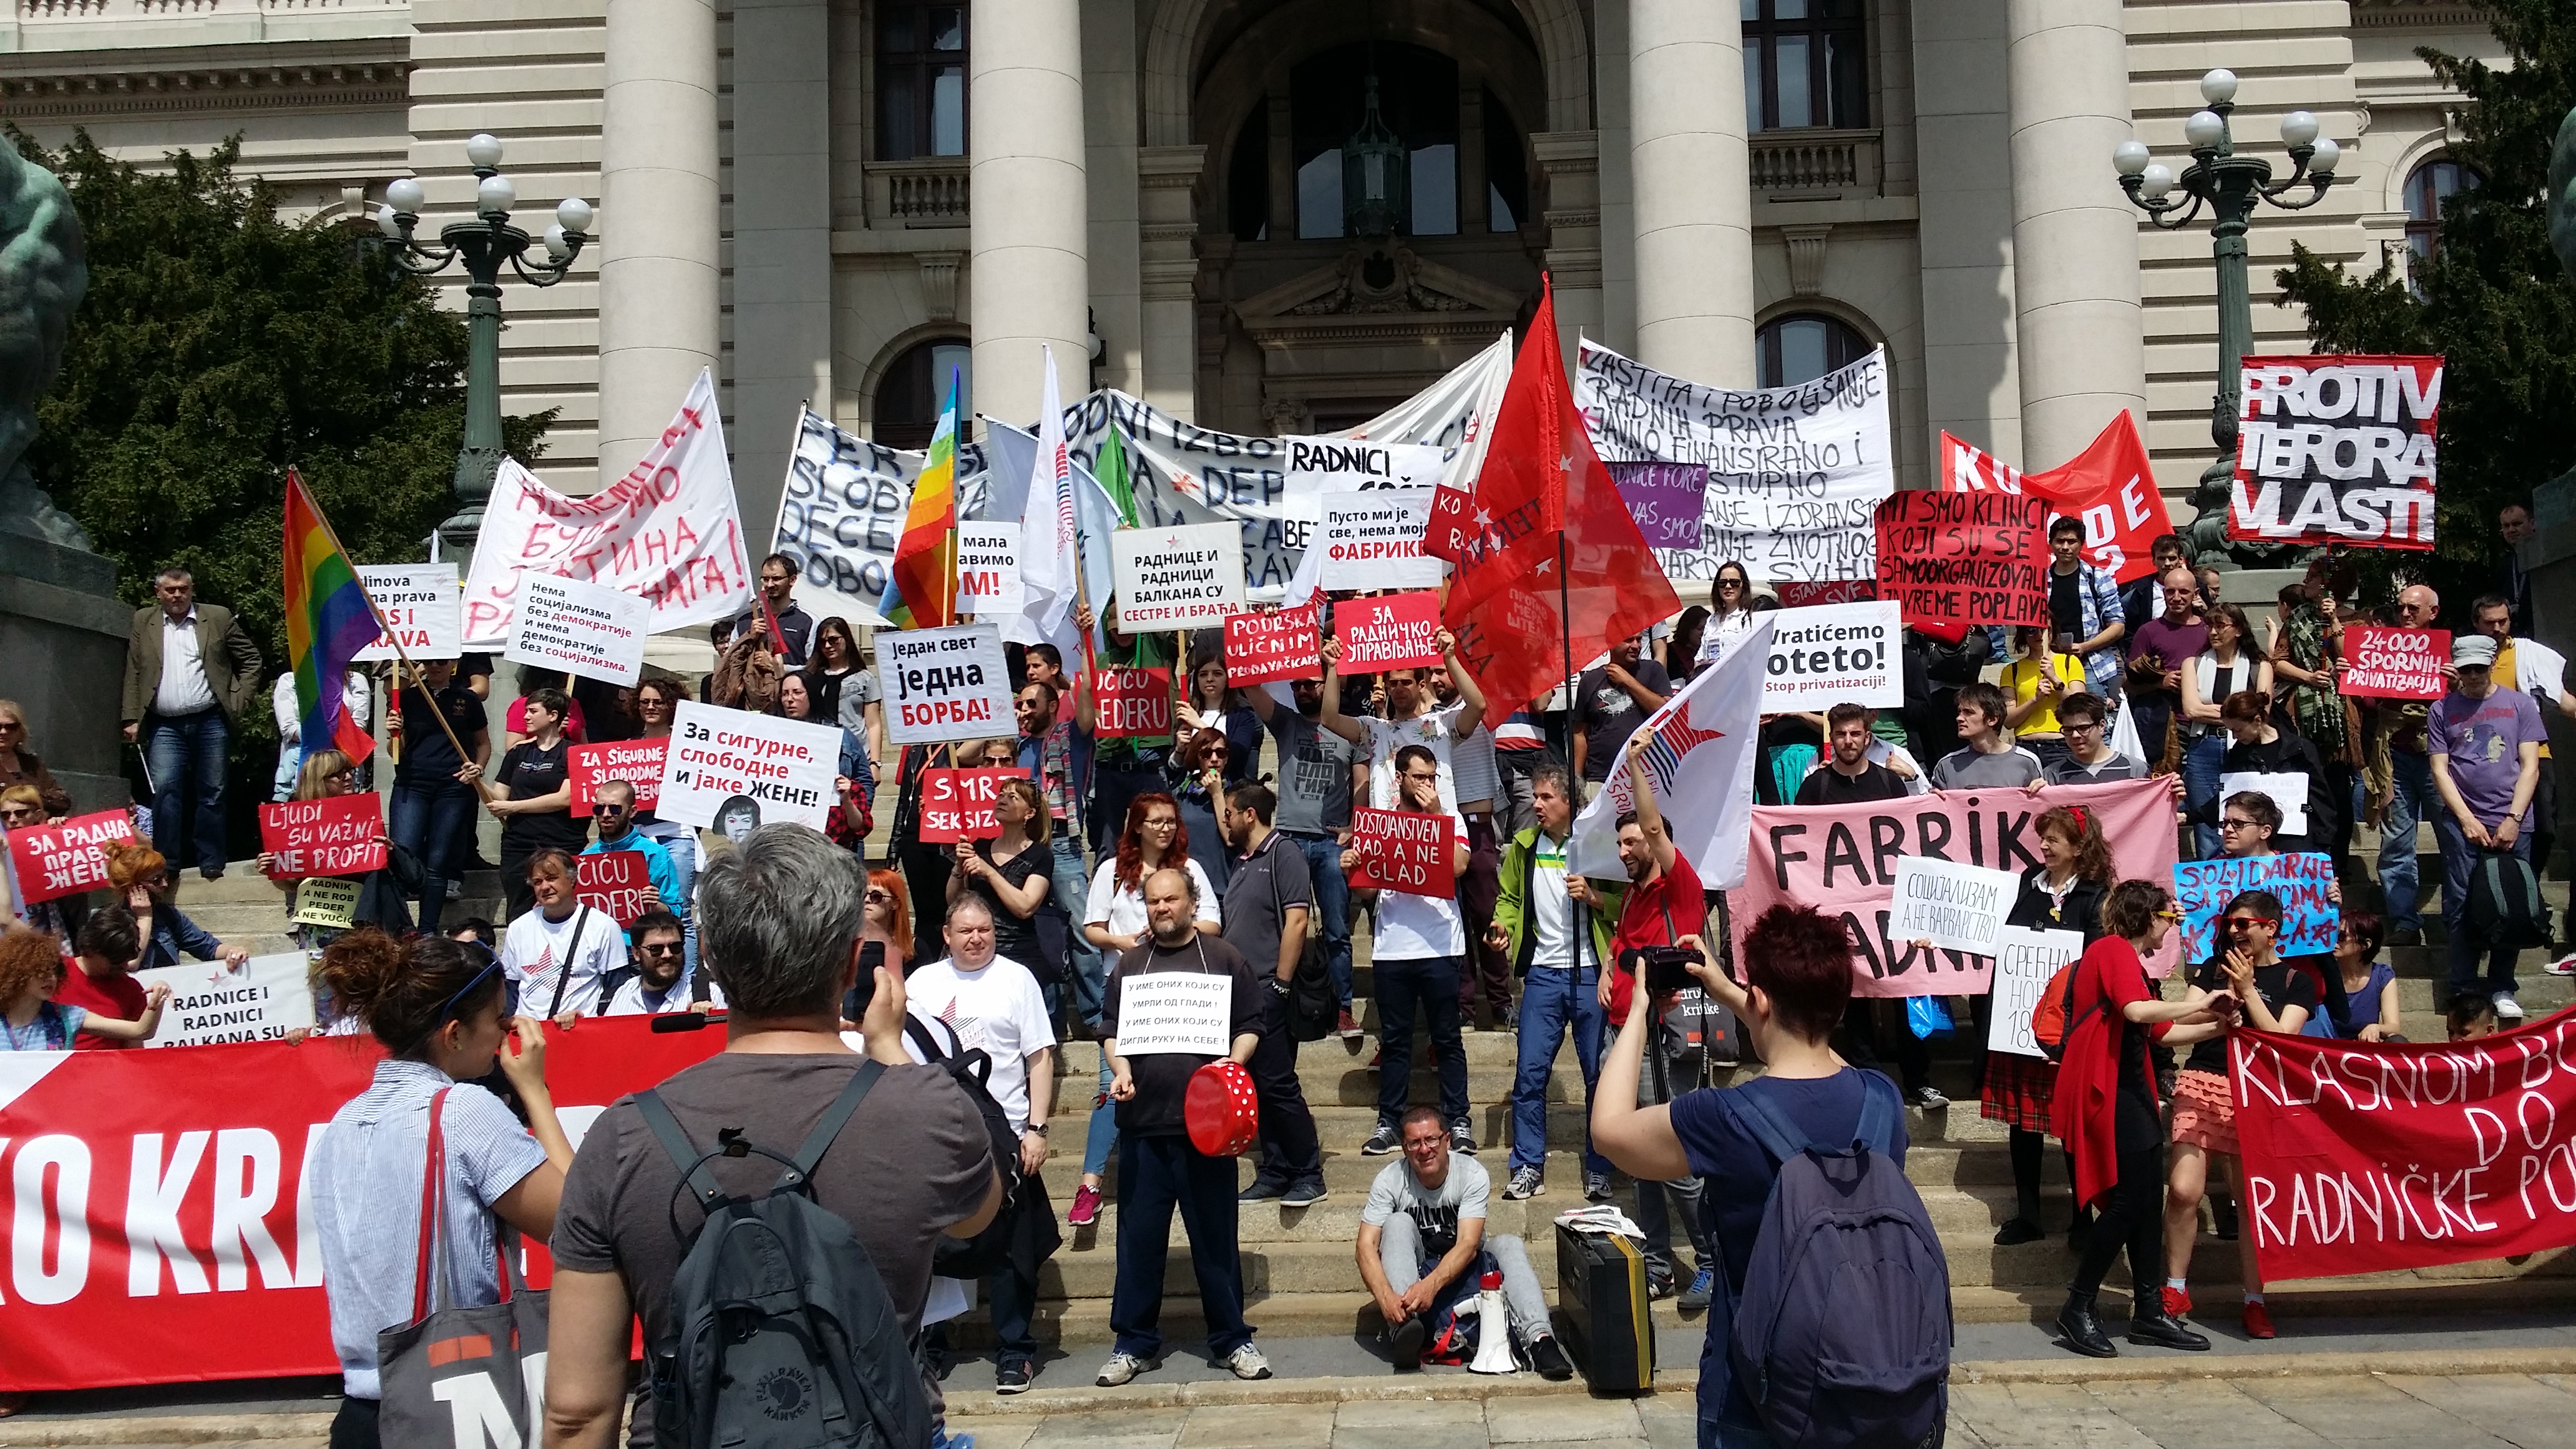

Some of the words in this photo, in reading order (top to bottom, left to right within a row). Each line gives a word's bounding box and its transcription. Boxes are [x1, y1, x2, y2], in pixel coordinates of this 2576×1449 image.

[2240, 365, 2443, 424] PROTIV
[1586, 376, 1693, 439] RADNIH
[1703, 412, 1801, 445] PRAVA
[1174, 420, 1277, 459] IZBO
[1592, 406, 1660, 455] JAVNO
[1672, 436, 1840, 473] FINANSIRANO
[1292, 442, 1390, 477] RADNICI
[2238, 421, 2436, 486] TERORA
[1608, 464, 1657, 487] ADNICE
[1709, 471, 1827, 499] STUPNO
[1329, 511, 1368, 525] Пусто
[1372, 510, 1392, 519] ми
[1396, 507, 1408, 522] је
[1777, 498, 1881, 530] ZDRAVST
[1881, 494, 1909, 522] MI
[1918, 491, 1965, 523] SMO
[1973, 494, 2047, 530] KLINCI
[2231, 480, 2434, 543] VLASTI
[964, 537, 1007, 548] мала
[1329, 527, 1355, 540] све,
[1359, 525, 1395, 537] нема
[1887, 525, 1935, 554] KOJI
[1947, 527, 1981, 556] SU
[1994, 530, 2032, 559] SE
[959, 555, 1013, 565] авимо
[1134, 551, 1204, 569] РАДНИЦЕ
[1207, 550, 1218, 562] И
[360, 575, 410, 587] linova
[957, 572, 1000, 596] М!
[1141, 568, 1214, 587] РАДНИЦИ
[1881, 555, 2046, 593] SAMOORGANIZOVALI
[393, 592, 436, 606] prava
[532, 583, 565, 597] Нема
[1134, 587, 1203, 603] БАЛКАНА
[1206, 585, 1224, 598] СУ
[530, 596, 612, 620] социјализма
[1125, 607, 1171, 622] СЕСТРЕ
[1175, 605, 1186, 618] И
[1189, 602, 1239, 618] БРАЋА
[1373, 606, 1395, 625] ЗА
[1903, 589, 1961, 617] VREME
[1969, 592, 2047, 624] POPLAVA
[527, 606, 549, 618] без
[552, 613, 632, 638] демократије
[537, 621, 569, 635] нема
[1350, 620, 1431, 643] РАДНИЧКО
[522, 631, 605, 654] демократије
[892, 641, 935, 660] Један
[940, 637, 977, 651] свет
[1227, 632, 1314, 657] ULIČNIM
[1347, 637, 1437, 663] УПРАВЉАЊЕ
[520, 641, 542, 653] без
[545, 647, 628, 673] социјализма.
[1767, 642, 1885, 676] oteto!
[2358, 650, 2441, 673] SPORNIH
[897, 663, 984, 700] једна
[1765, 682, 1795, 693] Stop
[1800, 676, 1886, 693] privatizaciji!
[2347, 668, 2441, 694] PRIVATIZACIJA
[900, 698, 991, 726] БОРБА!
[1096, 696, 1168, 730] EDERU
[685, 723, 710, 741] За
[717, 731, 814, 762] сигурне,
[580, 752, 601, 767] ZA
[680, 748, 789, 779] слободне
[591, 764, 663, 785] SLOBODNE
[676, 771, 690, 783] и
[692, 770, 743, 794] јаке
[748, 780, 819, 807] ЖЕНЕ!
[934, 776, 1019, 801] SMR
[288, 827, 312, 846] SU
[319, 813, 376, 843] VAŽNI
[925, 809, 1002, 831] SEKSIZ
[1354, 811, 1440, 843] DOSTOJANSTVEN
[27, 834, 56, 855] ЗА
[62, 819, 131, 847] РАДНА
[1769, 798, 2041, 890] FABRIK
[44, 847, 110, 871] ПРАВ
[275, 849, 305, 872] NE
[313, 839, 384, 869] PROFIT
[1353, 836, 1386, 860] RAD,
[1394, 842, 1406, 861] A
[1417, 844, 1440, 864] NE
[44, 861, 109, 890] ЖЕН
[1367, 860, 1426, 885] GLAD
[2179, 853, 2333, 887] SOLIDARNE
[311, 880, 351, 891] RADNIK
[313, 890, 328, 899] NE
[331, 893, 354, 902] ROB
[1908, 873, 1997, 912] СОЦИЈАЛИЗАМ
[309, 900, 344, 912] PEDER
[1902, 903, 1911, 929] А
[1914, 904, 1926, 932] НЕ
[1929, 905, 1996, 944] ВАРВАРСТВО
[1136, 982, 1154, 990] ИМЕ
[1186, 982, 1209, 990] КОЈИ
[173, 988, 258, 1012] RADNICE
[263, 986, 269, 1000] I
[1133, 1000, 1161, 1008] УМРЛИ
[1164, 998, 1178, 1007] ОД
[1181, 999, 1211, 1008] ГЛАДИ
[183, 1007, 263, 1030] RADNICI
[1133, 1018, 1151, 1026] ИМЕ
[262, 1025, 286, 1041] SU
[1120, 1037, 1149, 1046] ДИГЛИ
[1194, 1036, 1219, 1045] СЕБЕ
[2233, 1038, 2495, 1110] KLASNOM
[2513, 1018, 2576, 1089] BO
[2251, 1163, 2497, 1248] RADNIČKE
